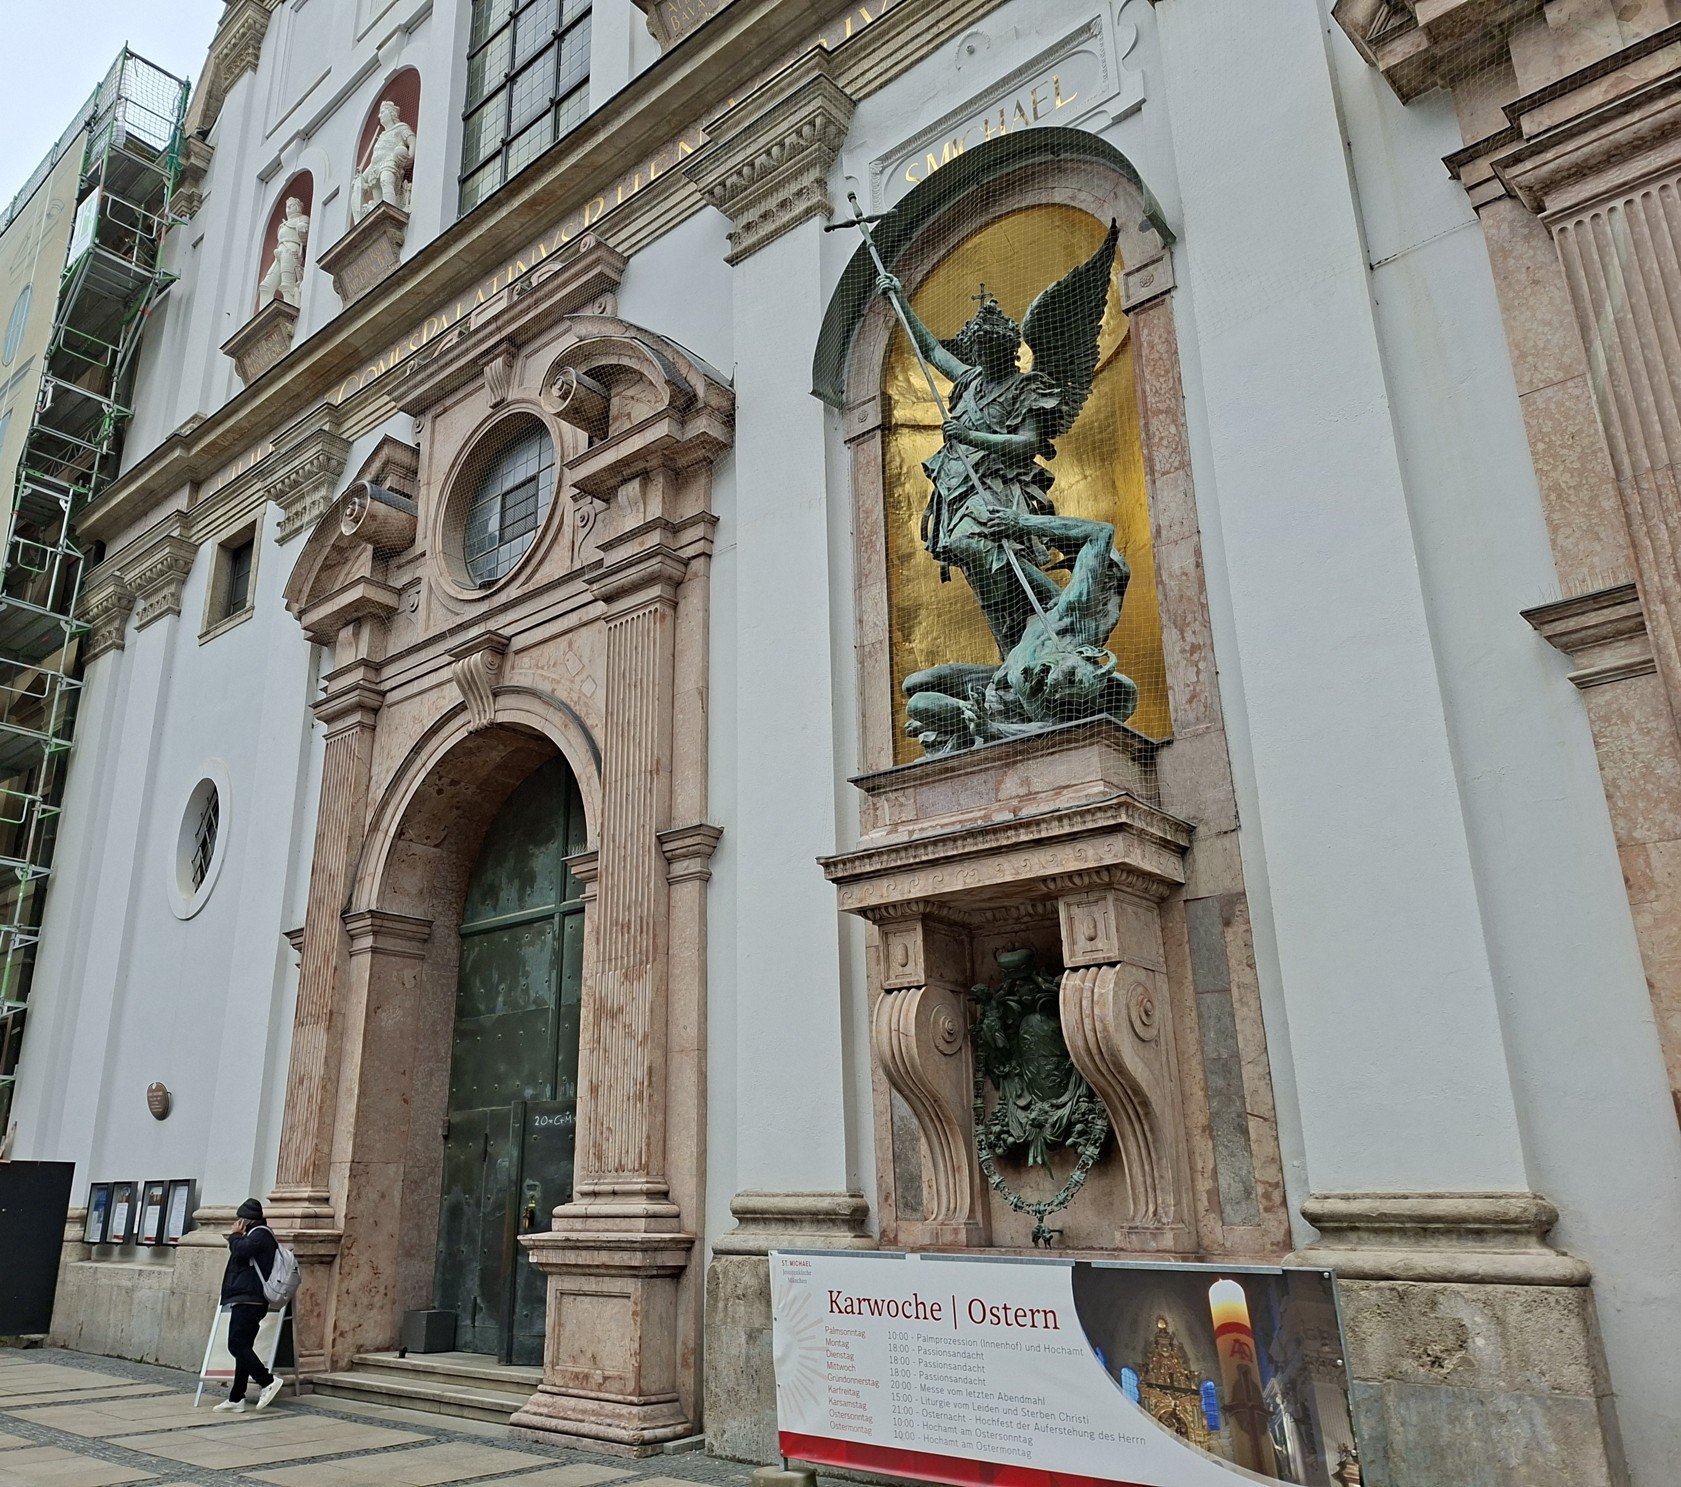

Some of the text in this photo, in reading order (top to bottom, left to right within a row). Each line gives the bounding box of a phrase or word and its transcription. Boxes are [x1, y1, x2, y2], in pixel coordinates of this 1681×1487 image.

[789, 1260, 812, 1268] MICHAEL
[827, 1290, 943, 1321] Karwoche
[968, 1298, 1061, 1330] Ostern
[824, 1325, 866, 1340] Palmsonntag
[825, 1337, 850, 1350] Montag
[916, 1333, 978, 1347] Palmprozession
[980, 1338, 1023, 1352] (Innenhof)
[1024, 1344, 1041, 1352] und
[1043, 1343, 1084, 1357] Hochamt
[826, 1348, 855, 1362] Dienstag
[917, 1345, 985, 1361] Passionsandacht
[826, 1360, 857, 1372] Mittwoch
[918, 1358, 986, 1374] Passionsandacht
[919, 1370, 987, 1387] Passionsandacht
[828, 1385, 861, 1399] Karfreitag
[920, 1383, 945, 1394] Messe
[947, 1389, 964, 1397] vom
[965, 1388, 995, 1401] letzten
[997, 1391, 1046, 1405] Abendmahl
[828, 1397, 868, 1412] Karsamstag
[921, 1396, 951, 1409] Liturgie
[953, 1401, 970, 1410] vom
[972, 1402, 1000, 1414] Leiden
[1002, 1406, 1019, 1415] und
[1021, 1407, 1056, 1421] Sterben
[1058, 1412, 1090, 1425] Christi
[829, 1408, 874, 1425] Ostersonntag
[830, 1420, 873, 1437] Ostermontag
[921, 1408, 967, 1423] Osternacht
[974, 1416, 1014, 1429] Hochfest
[1016, 1420, 1031, 1431] der
[1033, 1423, 1096, 1441] Auferstehung
[1098, 1430, 1116, 1442] des
[1118, 1433, 1147, 1446] Herrn
[922, 1421, 958, 1435] Hochamt
[975, 1428, 1034, 1447] Ostersonntag
[923, 1434, 959, 1447] Hochamt
[961, 1441, 974, 1449] am
[976, 1441, 1033, 1459] Ostermontag
